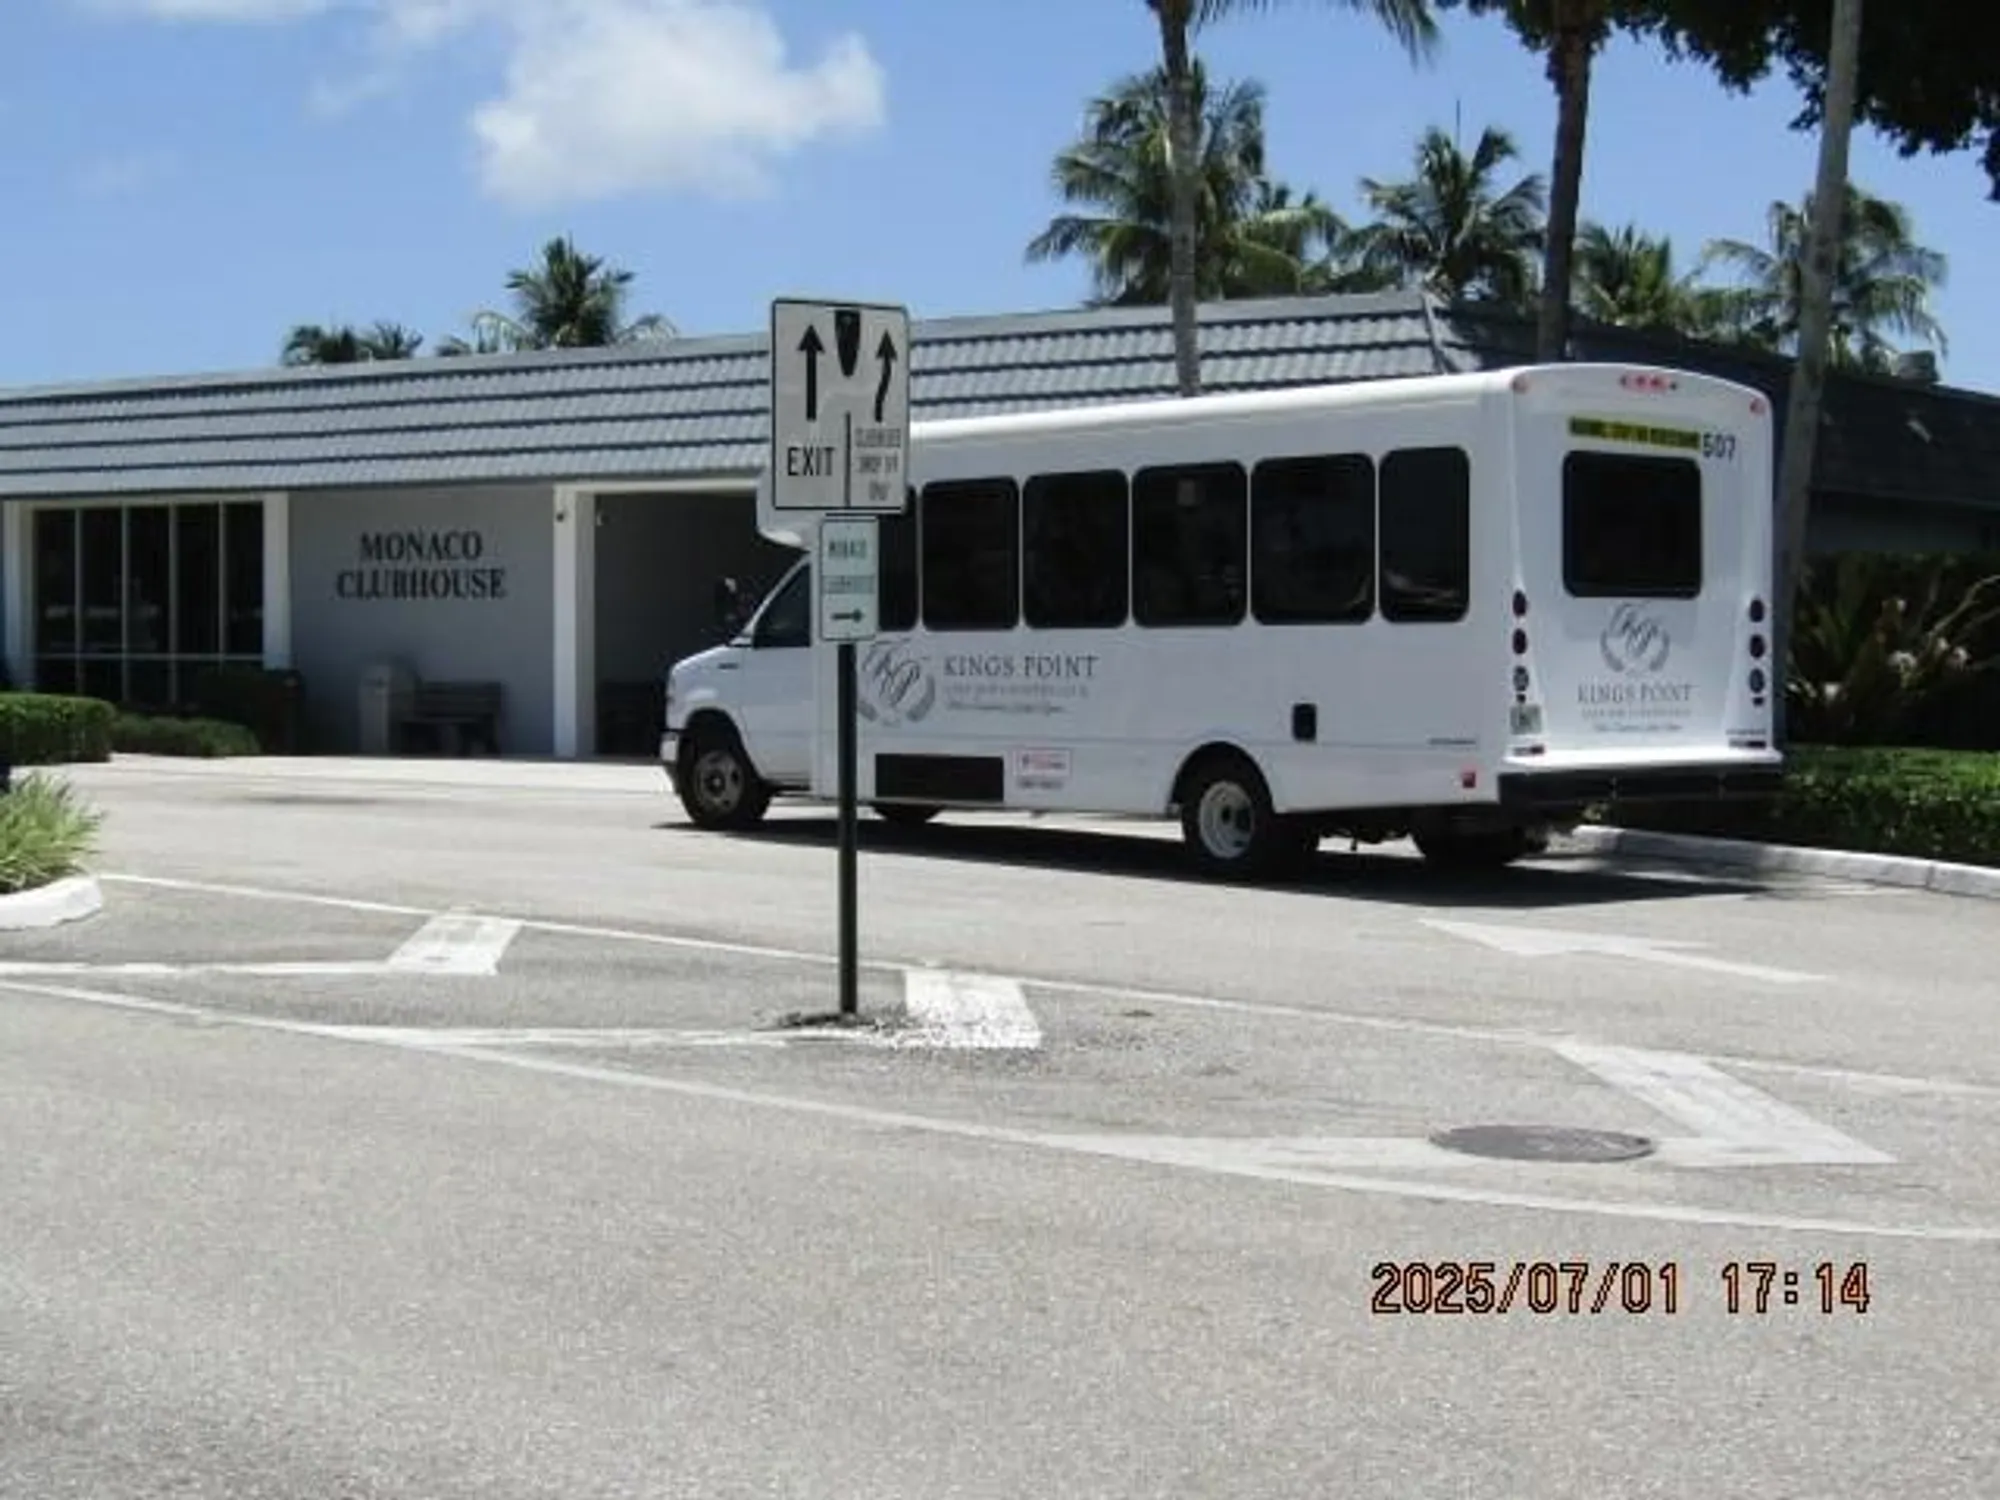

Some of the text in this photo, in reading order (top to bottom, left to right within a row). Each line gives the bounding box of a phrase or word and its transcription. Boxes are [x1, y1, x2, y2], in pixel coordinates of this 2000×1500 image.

[1702, 432, 1736, 459] 507
[786, 446, 835, 477] EXIT
[360, 529, 483, 562] MONACO
[335, 566, 507, 600] CLUBHOUSE
[944, 654, 1098, 679] KINGS POINT
[1577, 682, 1695, 704] KINGS POINT
